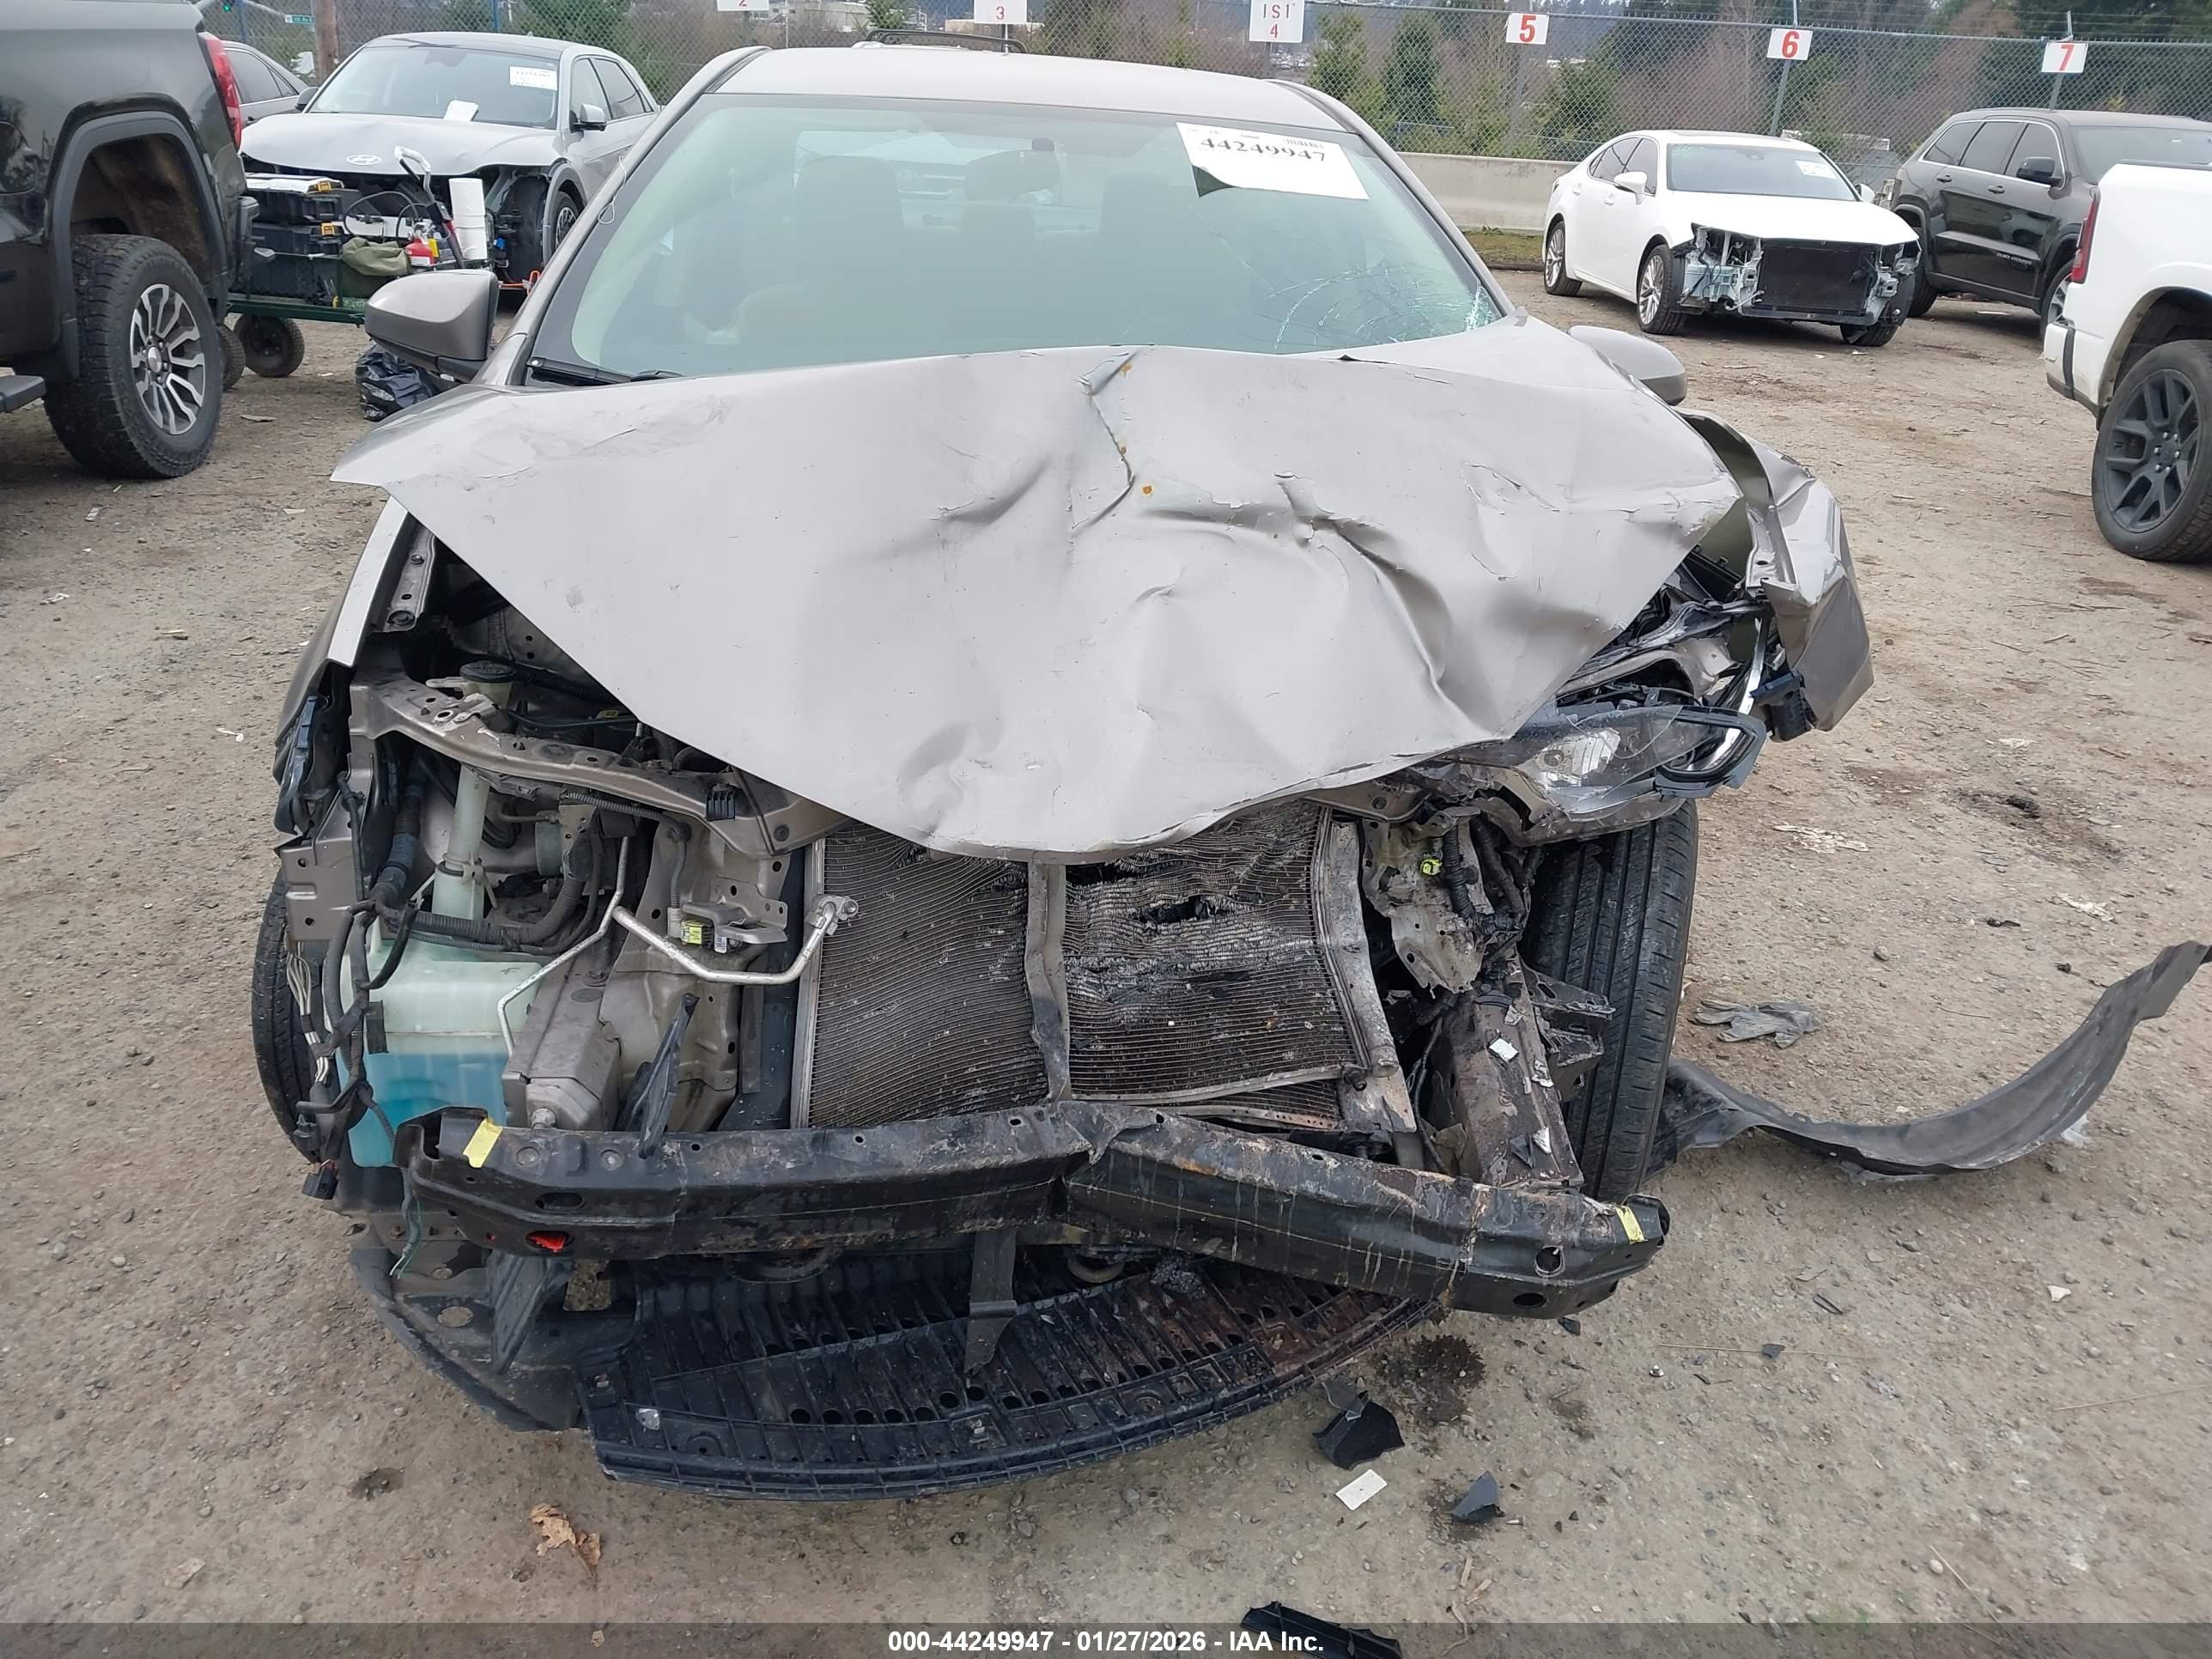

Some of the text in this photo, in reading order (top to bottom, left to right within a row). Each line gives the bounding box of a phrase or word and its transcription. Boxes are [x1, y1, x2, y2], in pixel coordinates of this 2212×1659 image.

[996, 6, 1005, 21] 3
[1270, 23, 1279, 39] 4
[1519, 15, 1537, 43] 5
[1782, 30, 1800, 58] 6
[2059, 44, 2075, 71] 7
[1200, 137, 1325, 161] 44249947
